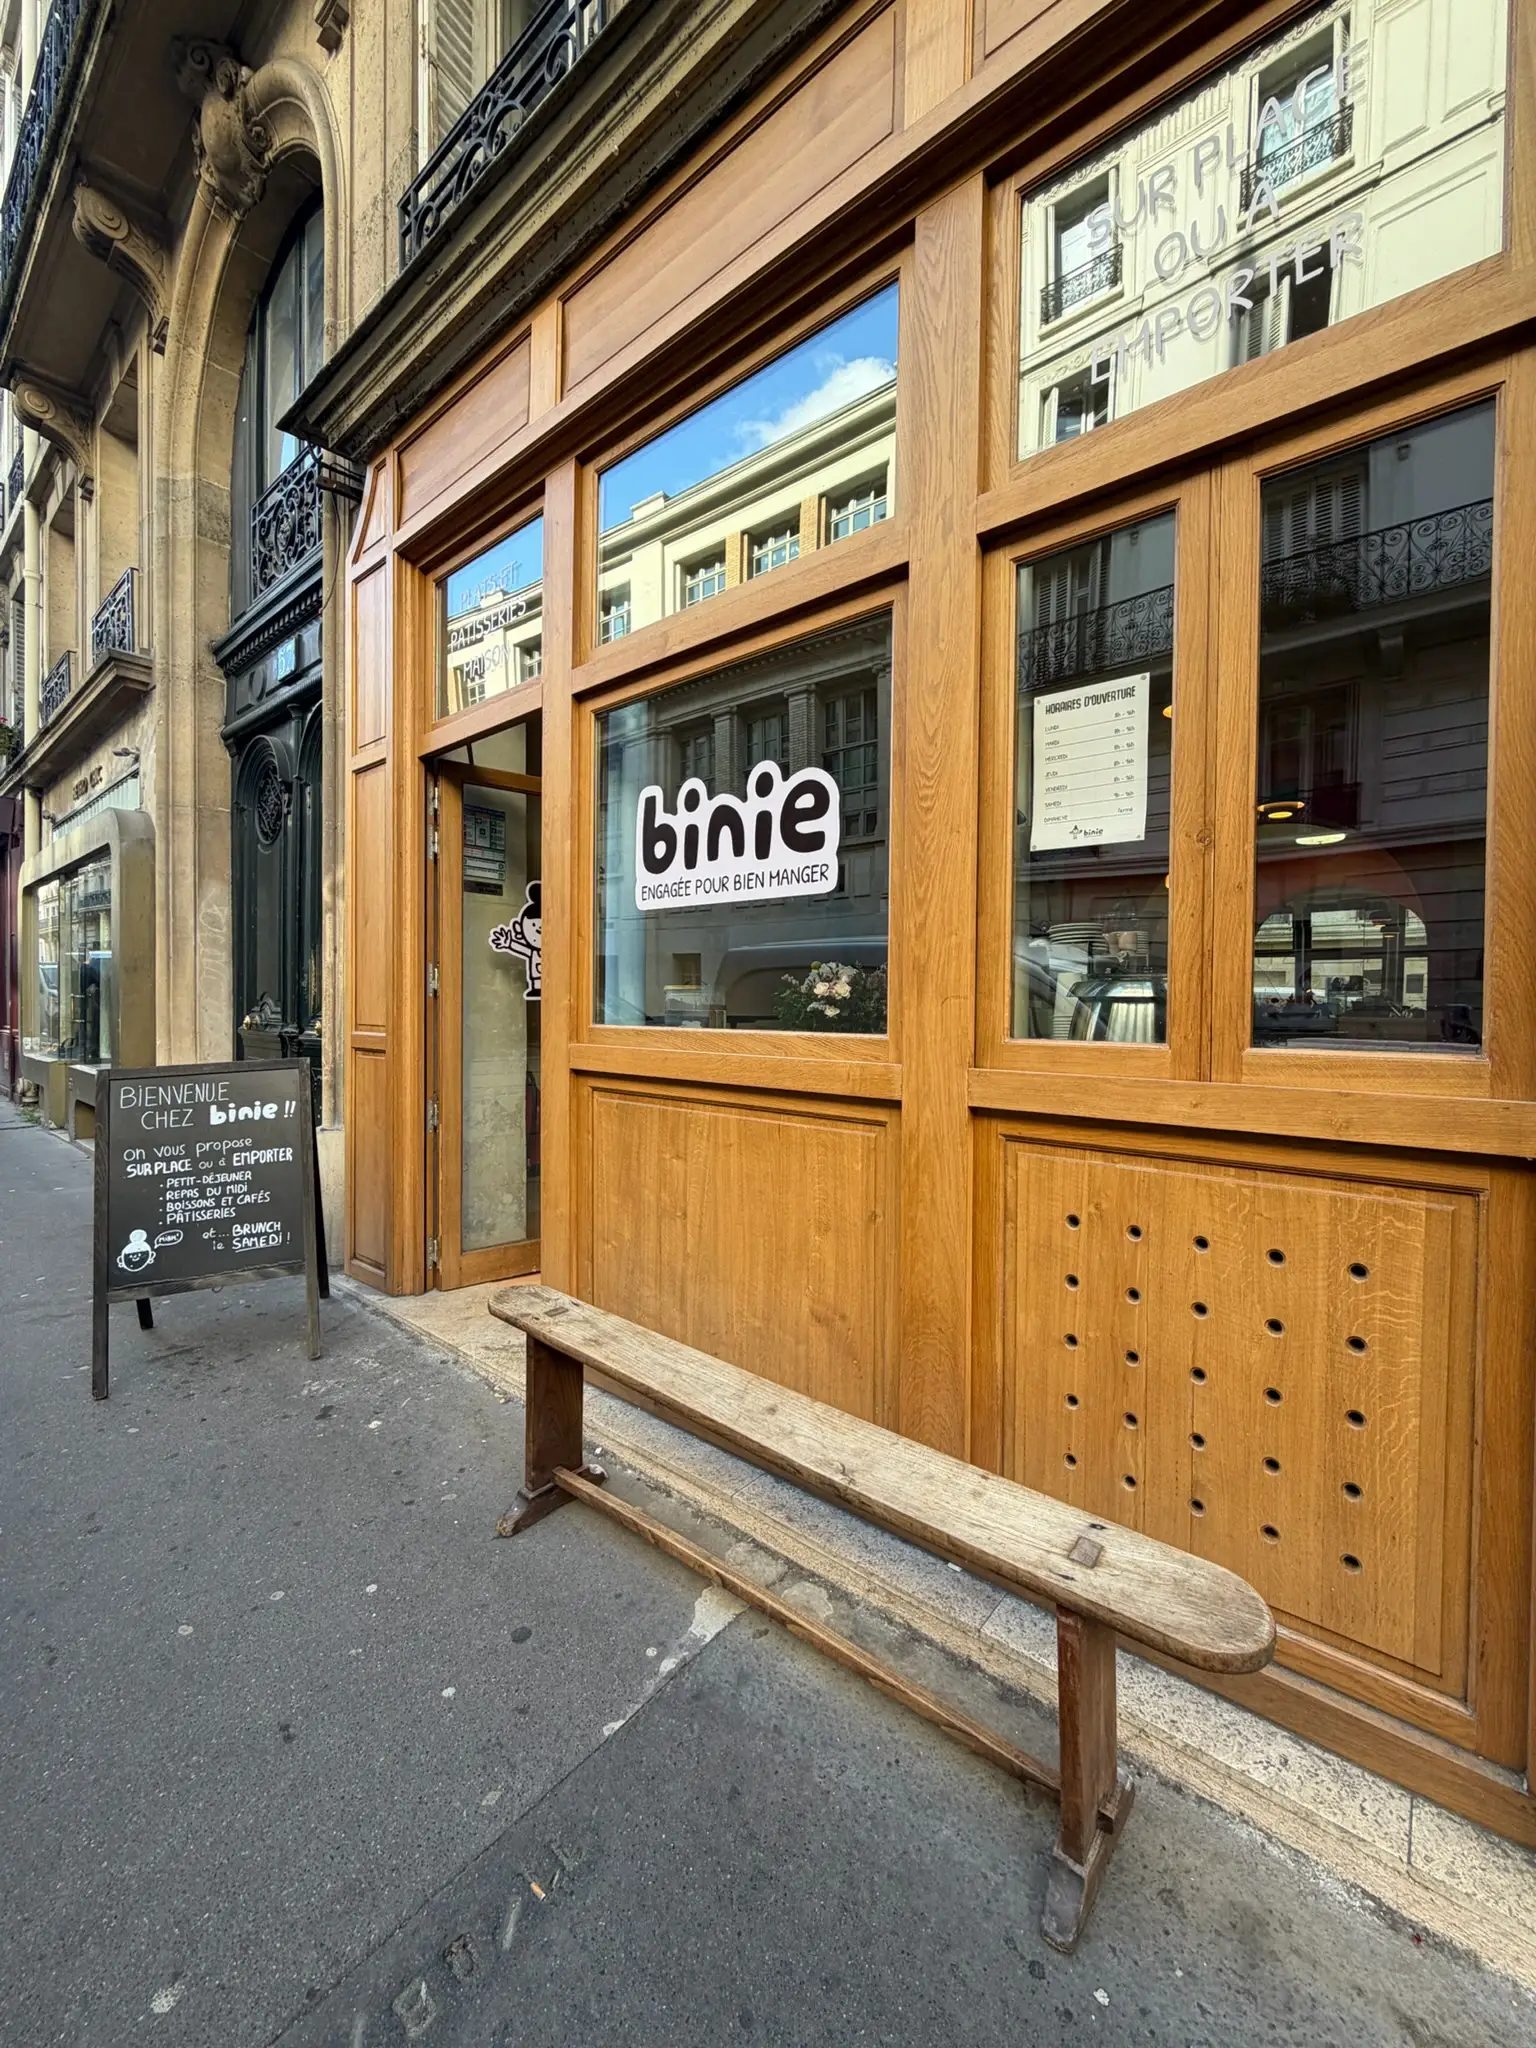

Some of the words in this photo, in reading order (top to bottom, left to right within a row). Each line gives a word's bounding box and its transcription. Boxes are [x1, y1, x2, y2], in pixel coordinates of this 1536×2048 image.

[1087, 165, 1175, 248] SUR
[1194, 39, 1368, 188] PLACE
[1154, 205, 1225, 284] OU
[1091, 211, 1363, 385] EMPORTER
[463, 642, 510, 681] MAISON
[1045, 698, 1081, 714] HORAIRES
[1083, 685, 1136, 707] D'OUVERTURE
[642, 771, 831, 874] binie
[1083, 828, 1103, 836] binie
[641, 877, 691, 901] ENGAGÉE
[695, 876, 729, 896] POUR
[733, 871, 765, 891] BIEN
[769, 863, 829, 887] MANGER
[141, 1108, 194, 1130] CHEZ
[209, 1100, 279, 1126] binie
[123, 1148, 146, 1162] on
[153, 1144, 186, 1158] vous
[196, 1138, 253, 1157] propose
[198, 1160, 214, 1170] ou
[233, 1147, 293, 1167] EMPORTER
[166, 1171, 252, 1189] PETIT-DÉJEUNER
[166, 1191, 200, 1201] REPAS
[206, 1187, 222, 1197] DU
[221, 1198, 233, 1207] ET
[236, 1190, 271, 1205] CAFÉS
[166, 1207, 236, 1225] PÂTISSERIES
[232, 1221, 281, 1237] BRUNCH
